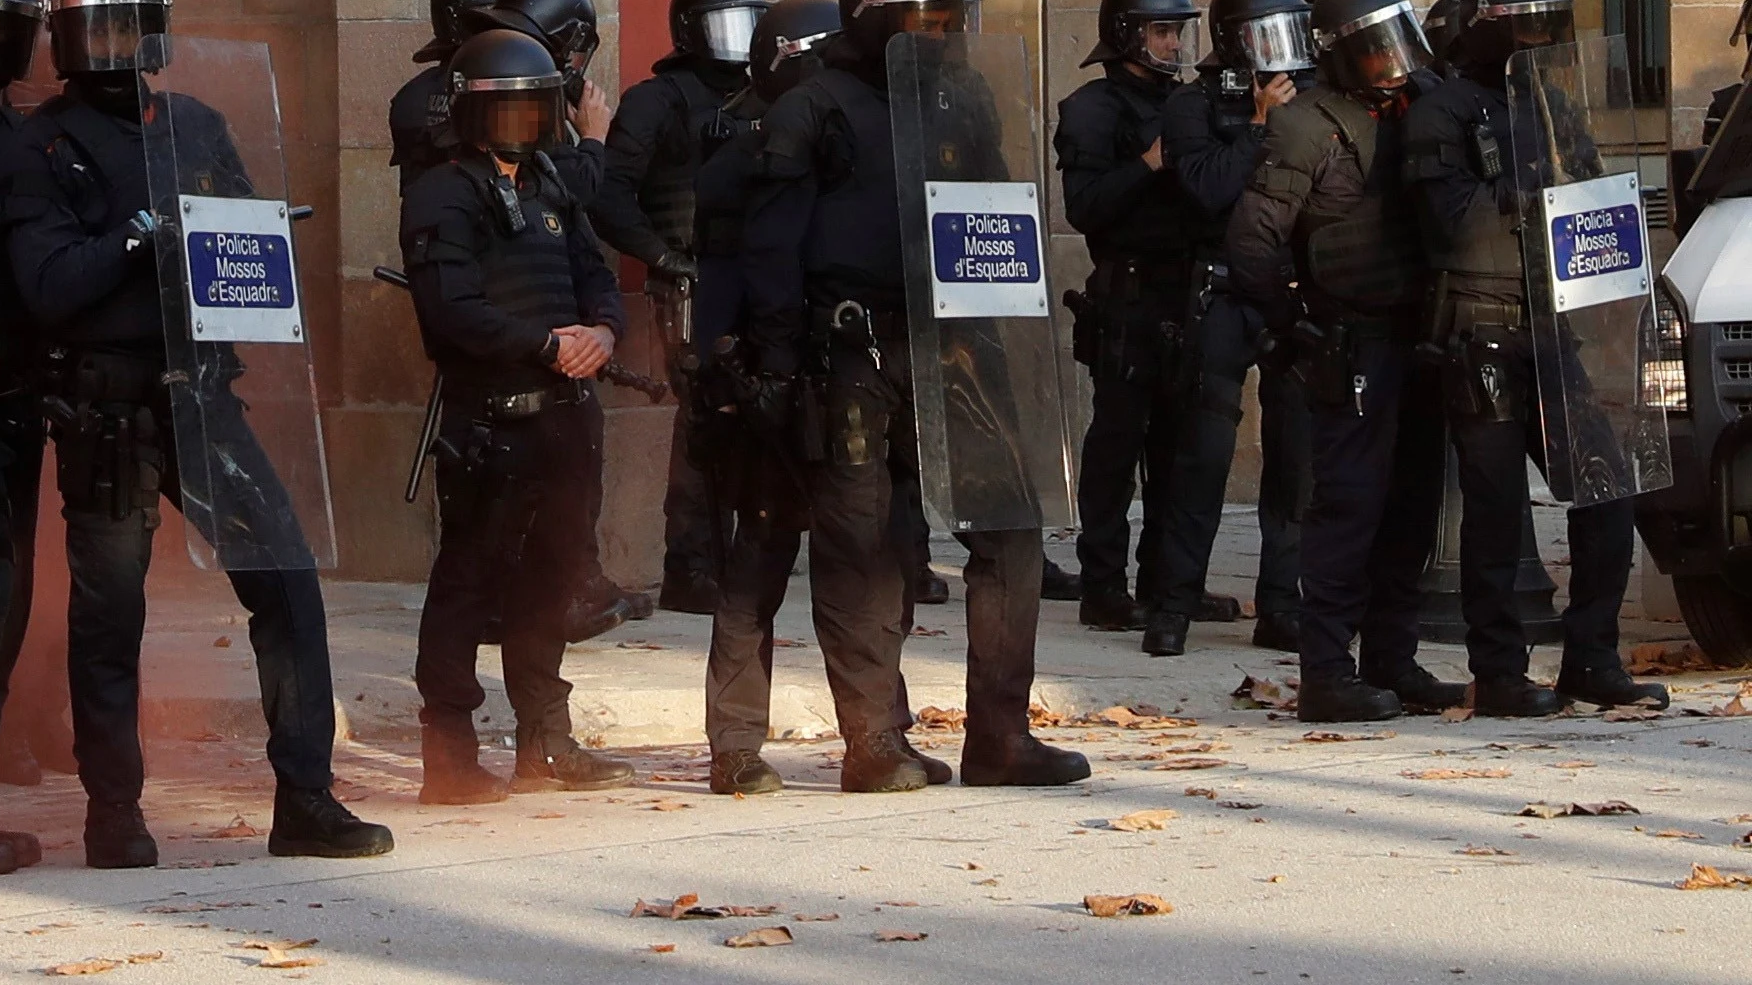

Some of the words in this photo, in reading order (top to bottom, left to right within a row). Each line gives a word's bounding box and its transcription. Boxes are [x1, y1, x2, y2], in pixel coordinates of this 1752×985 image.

[966, 215, 1011, 234] Policia
[1576, 210, 1614, 233] Policia
[216, 234, 261, 256] Policia
[964, 236, 1016, 256] Mossos
[1575, 232, 1619, 254] Mossos
[216, 257, 266, 279] Mossos
[955, 258, 1029, 282] d'Esquadra
